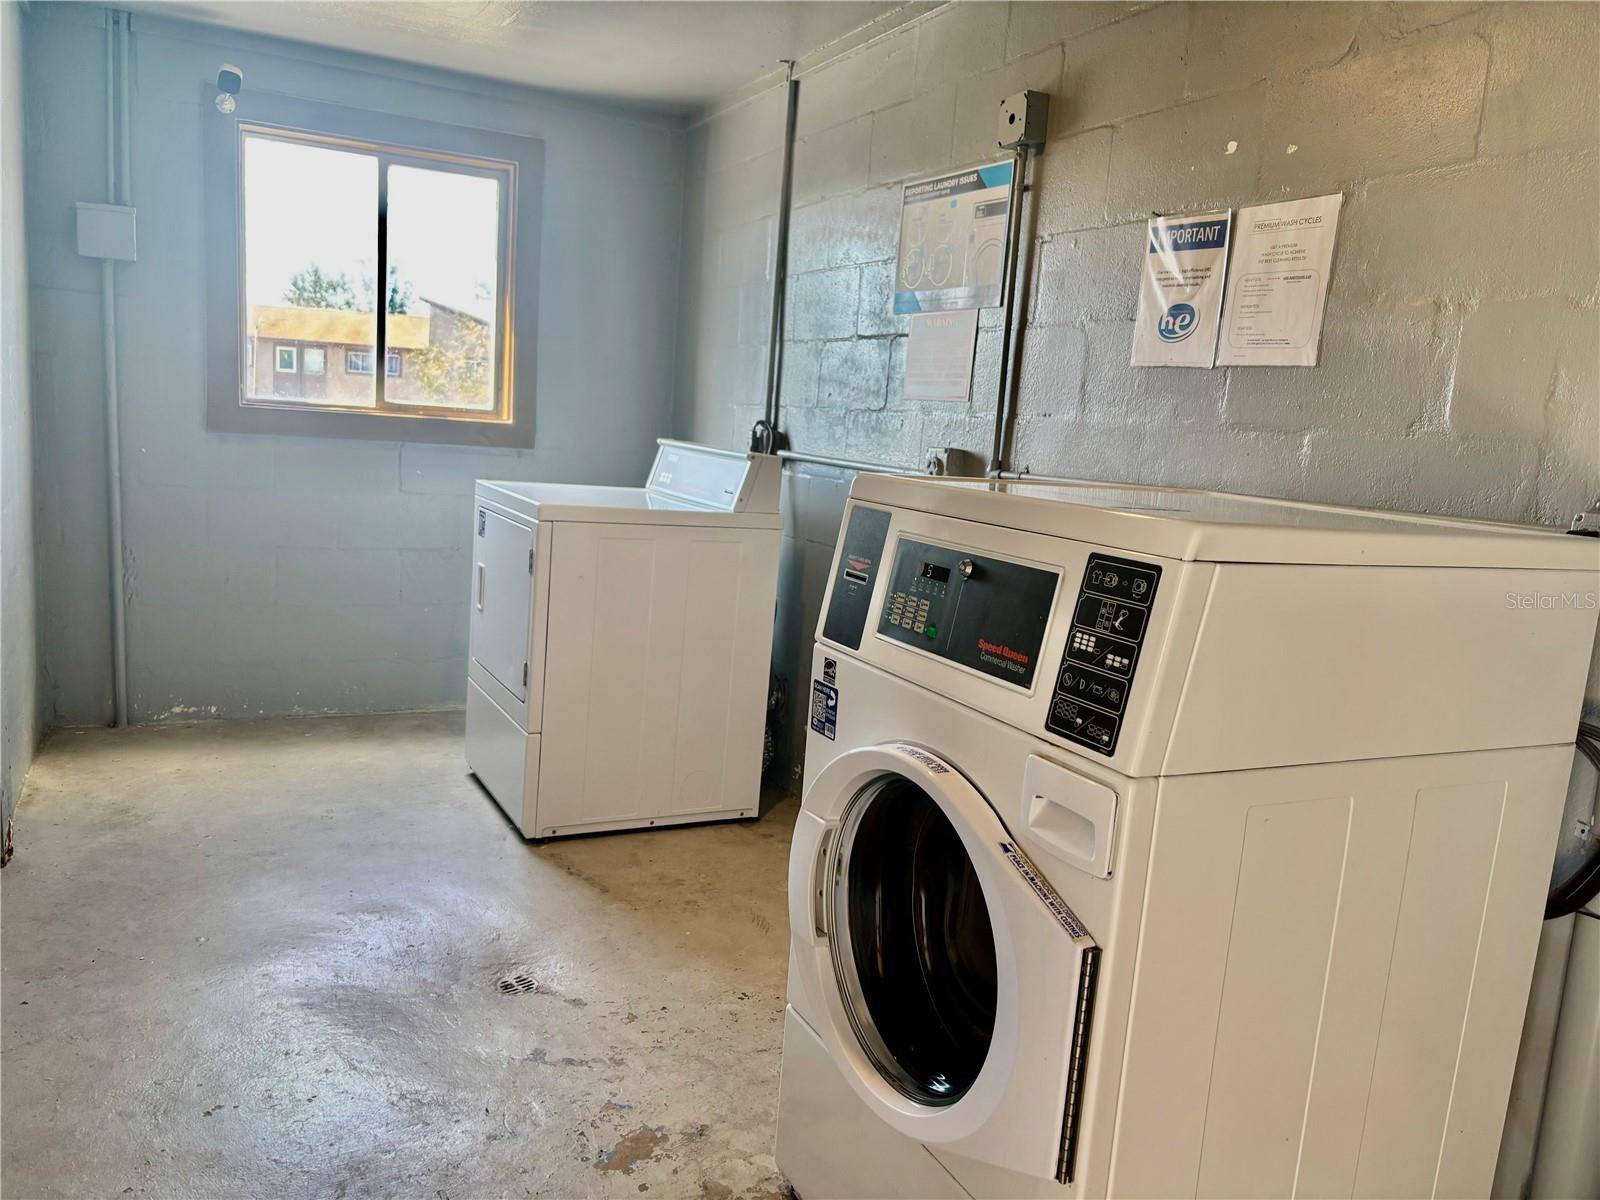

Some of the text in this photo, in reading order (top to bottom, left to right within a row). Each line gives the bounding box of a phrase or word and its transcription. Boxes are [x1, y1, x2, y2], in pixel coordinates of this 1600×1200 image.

[905, 185, 933, 196] REPORTING
[934, 179, 959, 192] LAUNDRY
[959, 173, 978, 186] ISSUES
[1254, 222, 1280, 230] PREMIUM
[1299, 216, 1322, 226] CYCLES
[978, 639, 1029, 664] Speed Queen
[980, 651, 1026, 674] Commercial Washer
[1010, 854, 1081, 938] PLACE IN MACHINE WITH CLOTHES
